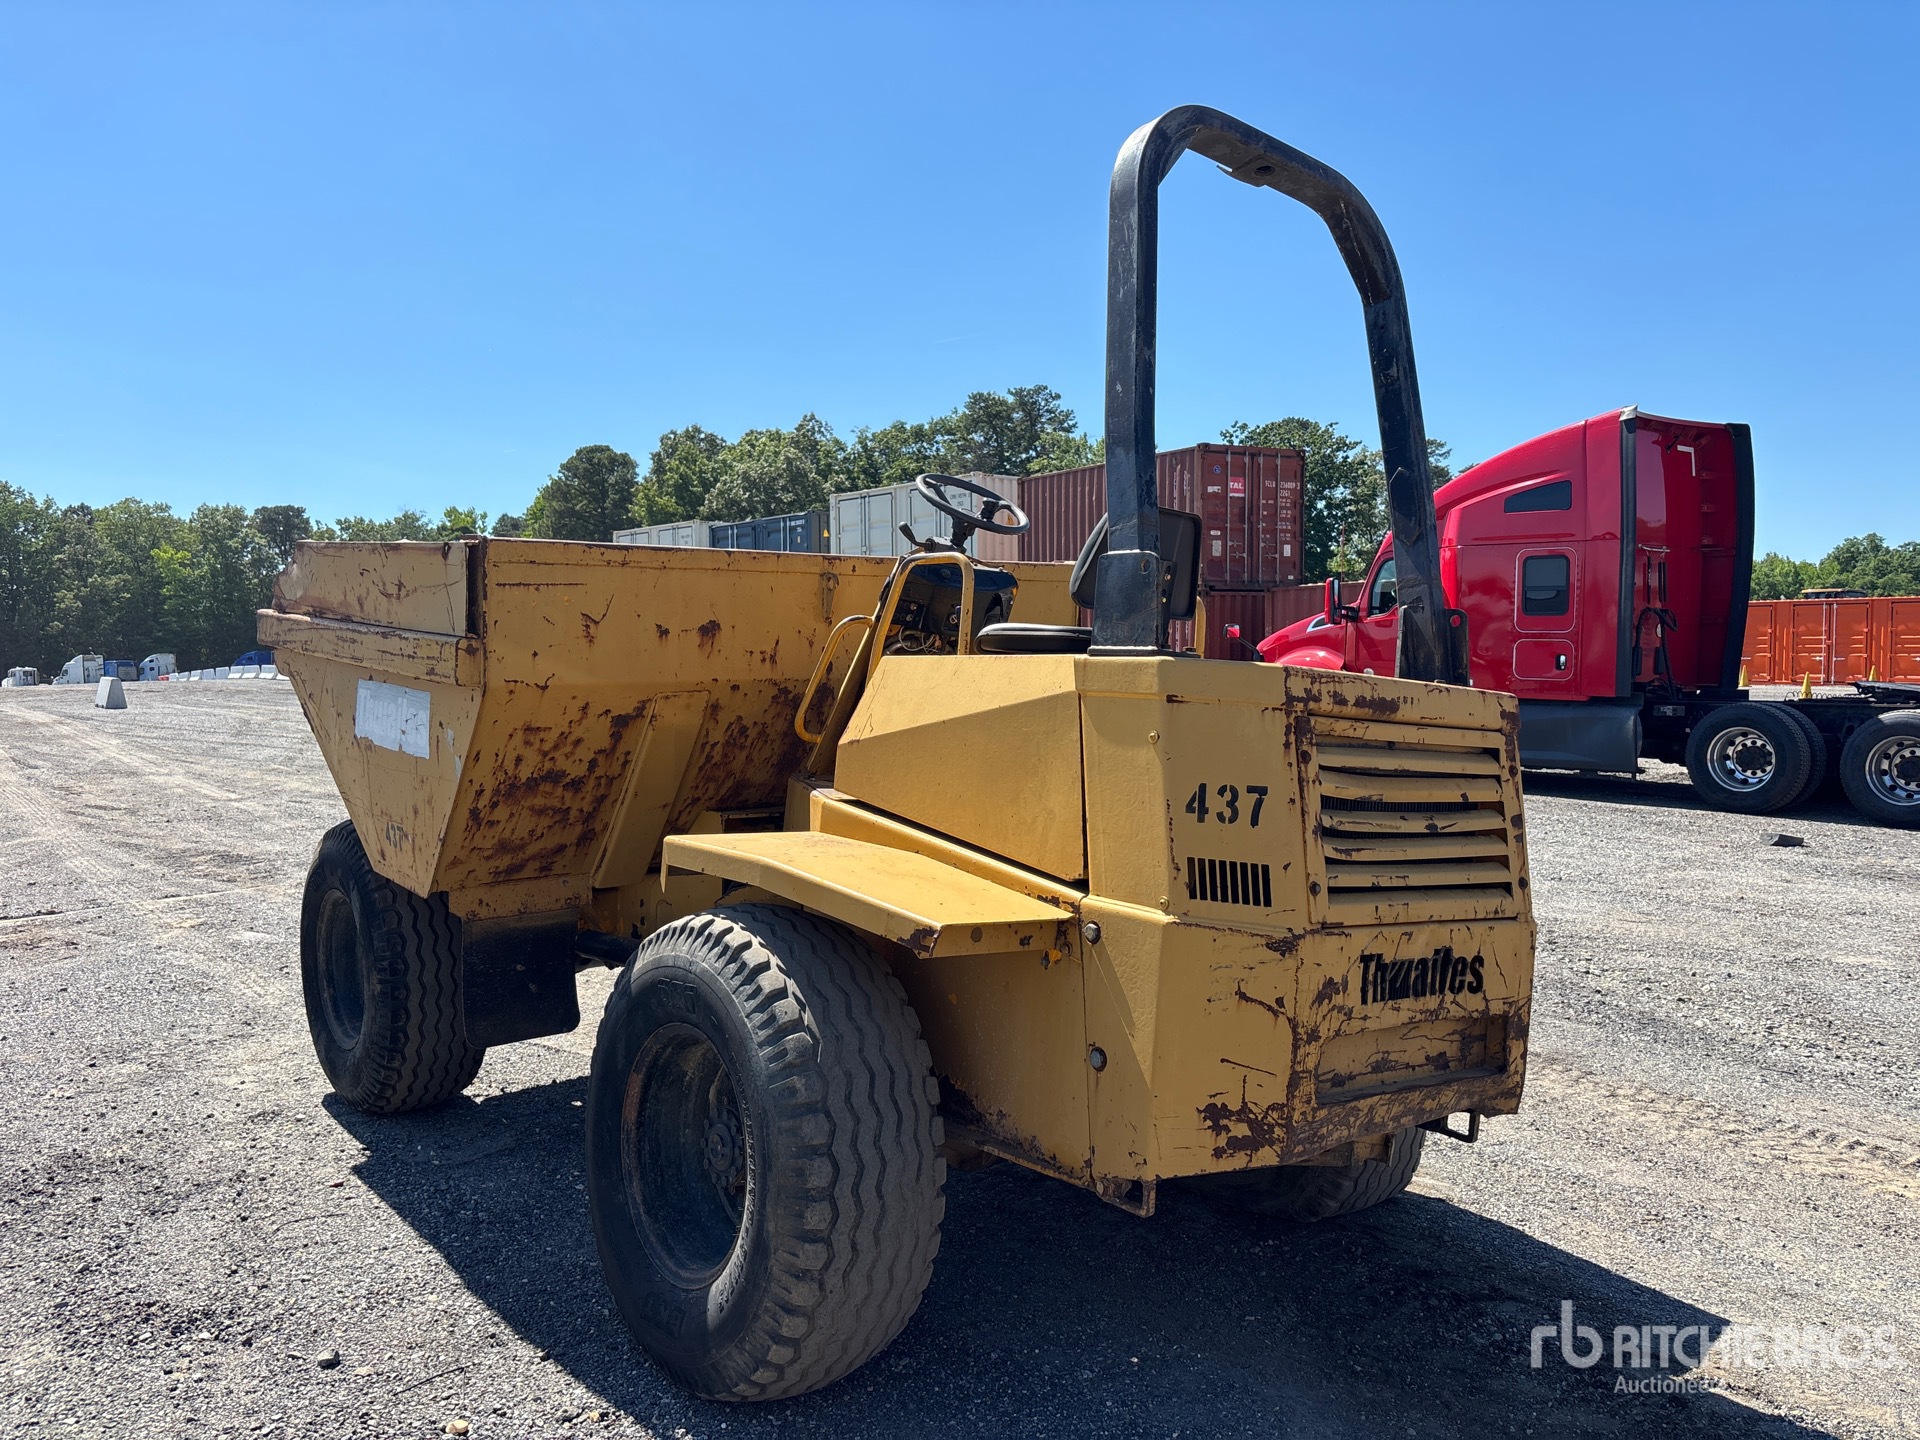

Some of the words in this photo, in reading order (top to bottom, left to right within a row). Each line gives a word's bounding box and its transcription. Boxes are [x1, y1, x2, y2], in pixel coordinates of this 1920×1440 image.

[1229, 481, 1244, 489] TAL
[1185, 782, 1268, 829] 437
[385, 821, 404, 852] 437
[1360, 945, 1484, 1005] Thwaites
